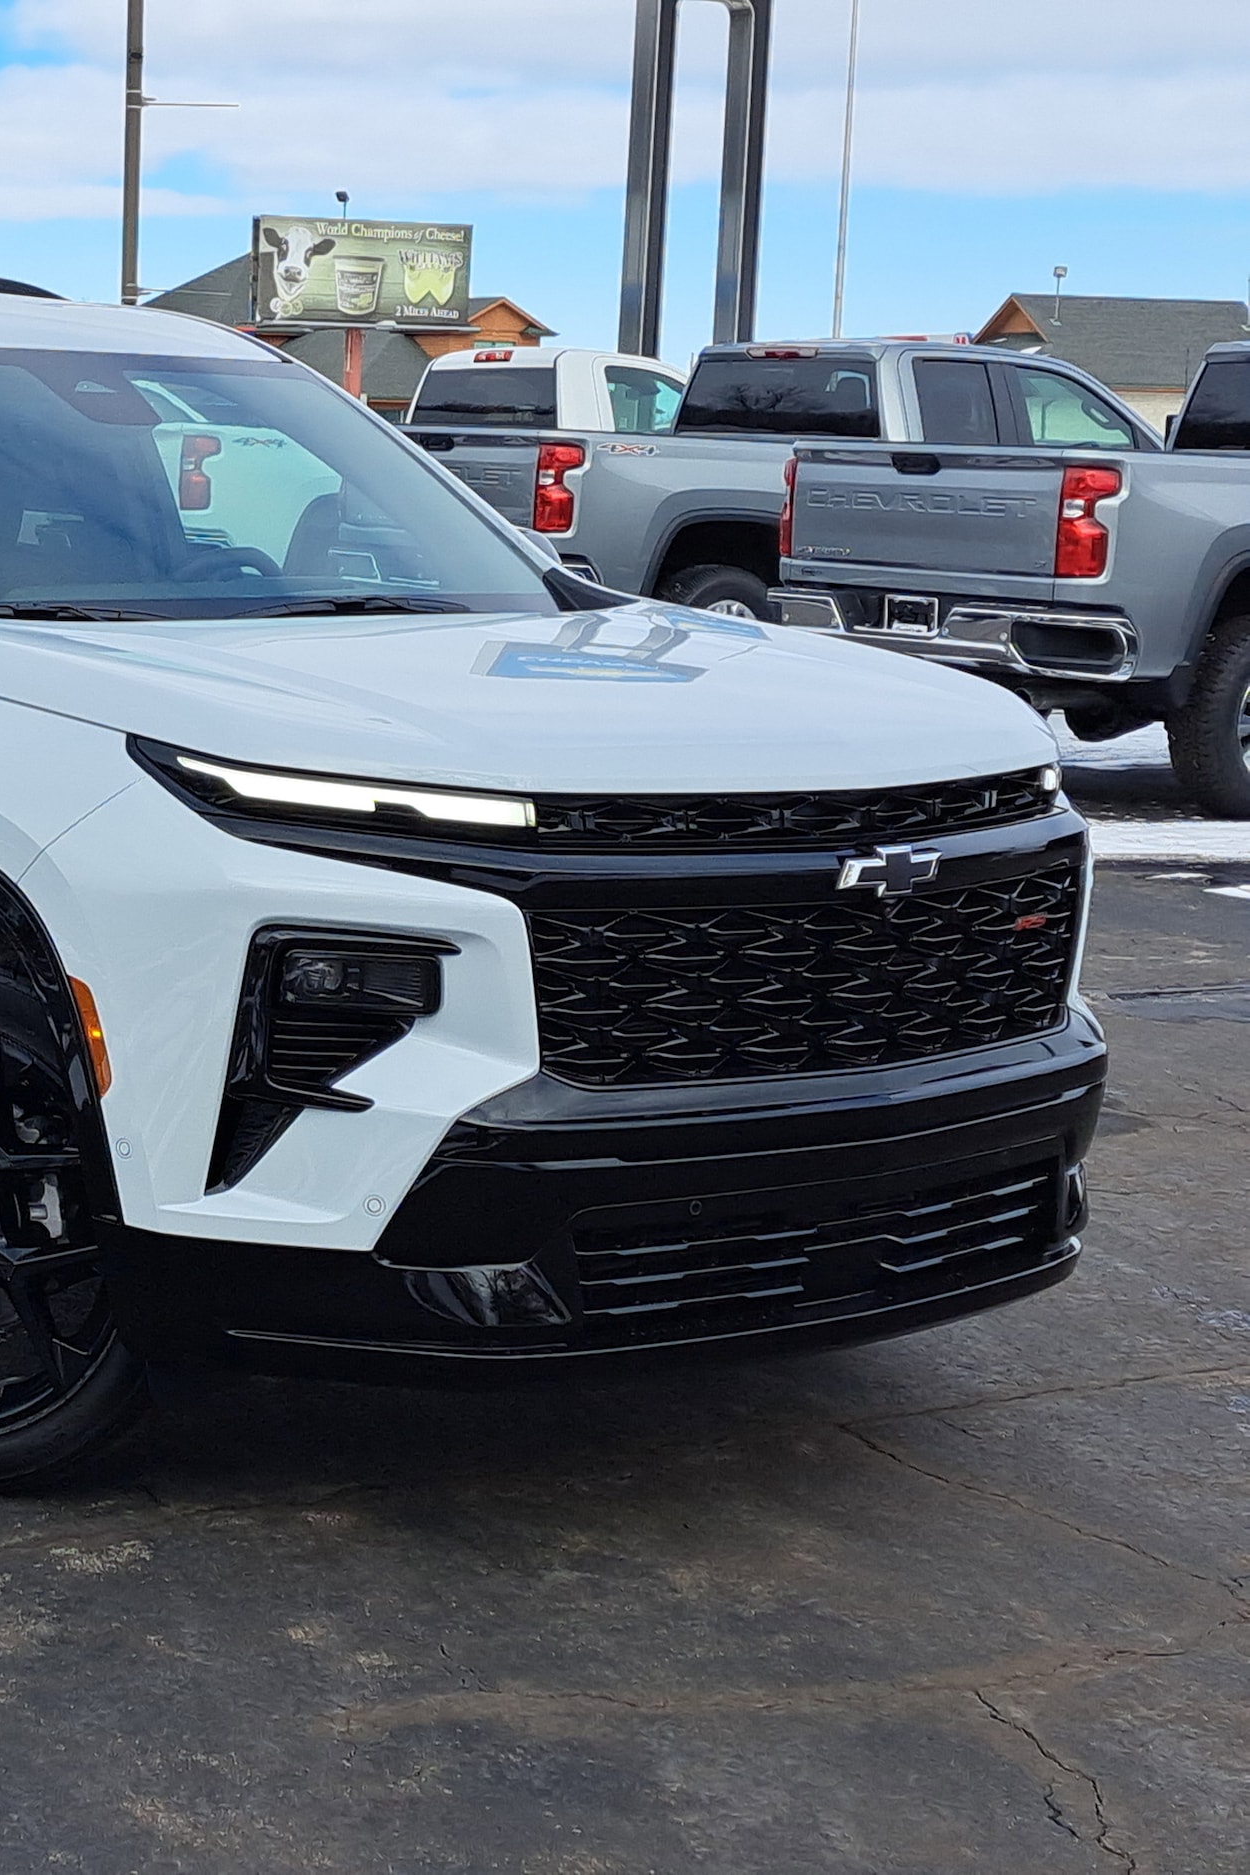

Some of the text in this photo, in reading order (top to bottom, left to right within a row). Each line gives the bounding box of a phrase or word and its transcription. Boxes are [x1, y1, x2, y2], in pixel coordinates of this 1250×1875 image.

[316, 222, 465, 244] World Champions of Cheese!
[395, 305, 402, 316] 2
[806, 487, 1038, 518] CHEVROLET
[1015, 912, 1047, 931] RS
